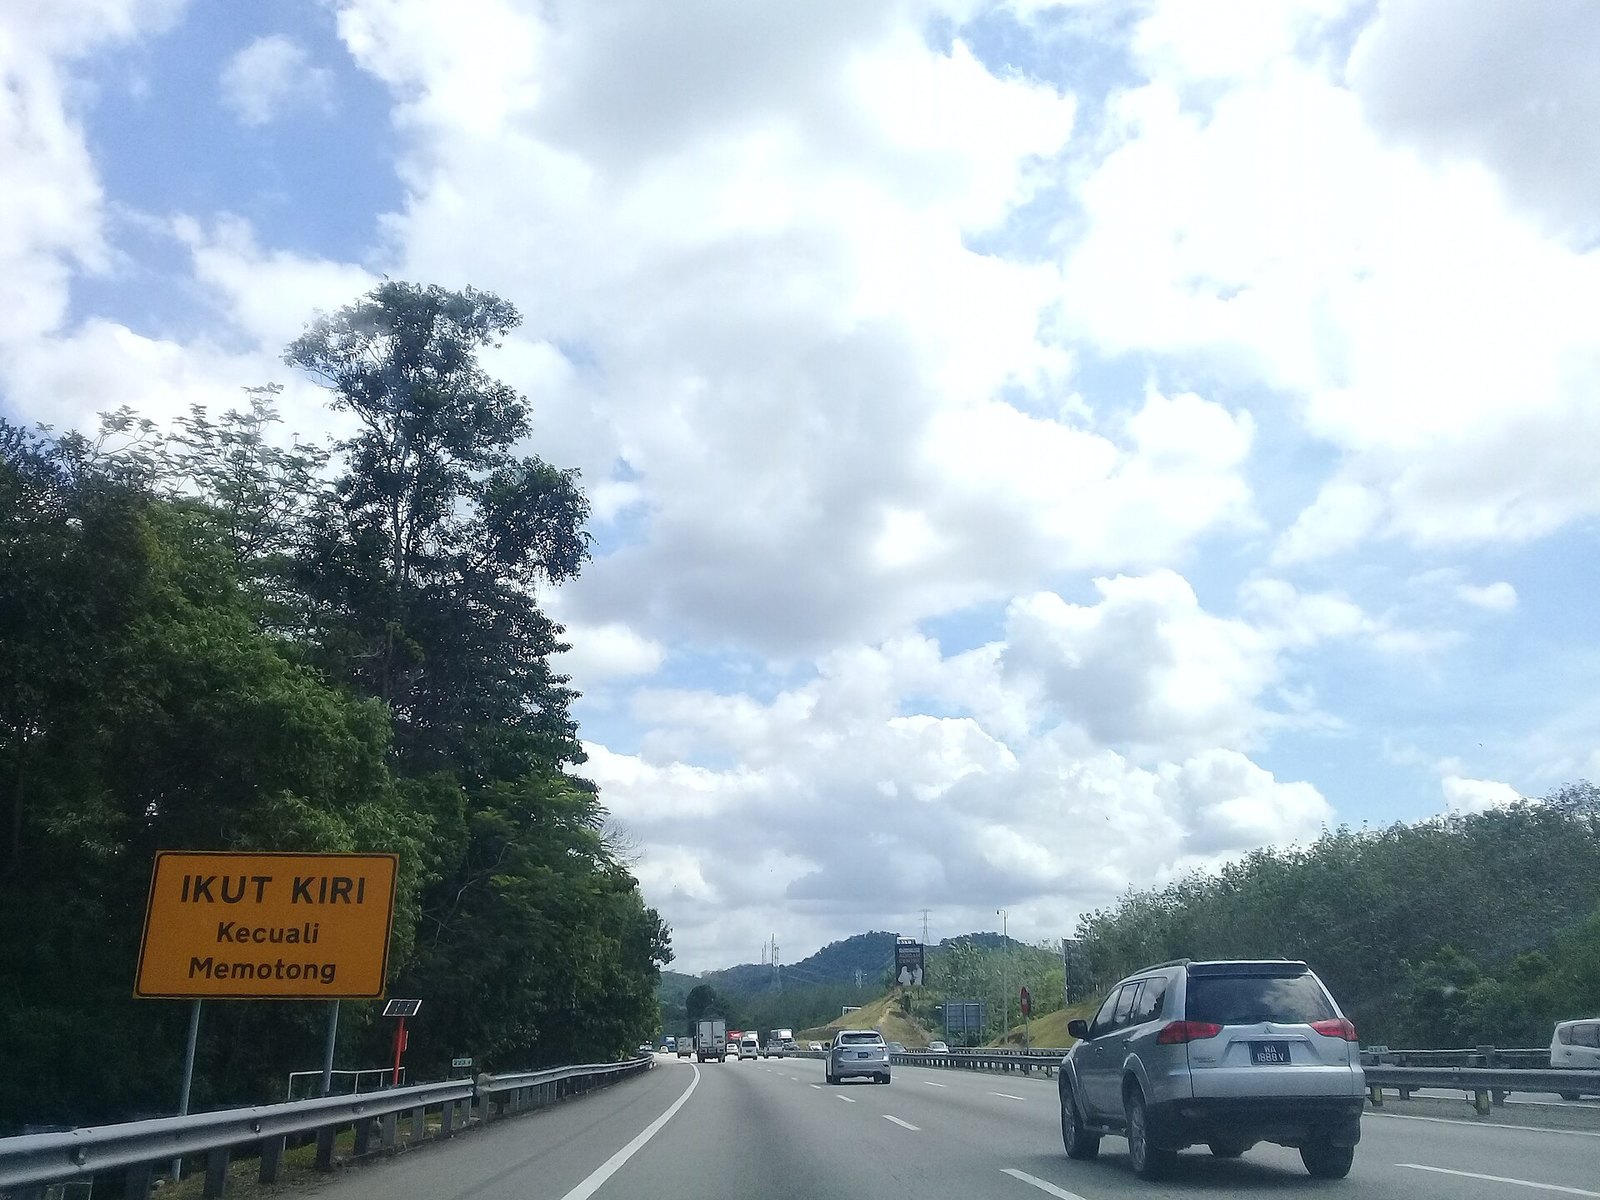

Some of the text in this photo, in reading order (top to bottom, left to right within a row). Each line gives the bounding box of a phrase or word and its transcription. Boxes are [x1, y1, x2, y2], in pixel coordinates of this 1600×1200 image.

[181, 875, 365, 904] IKUT KIRI
[216, 922, 320, 944] Kecuali
[188, 957, 336, 984] Memotong
